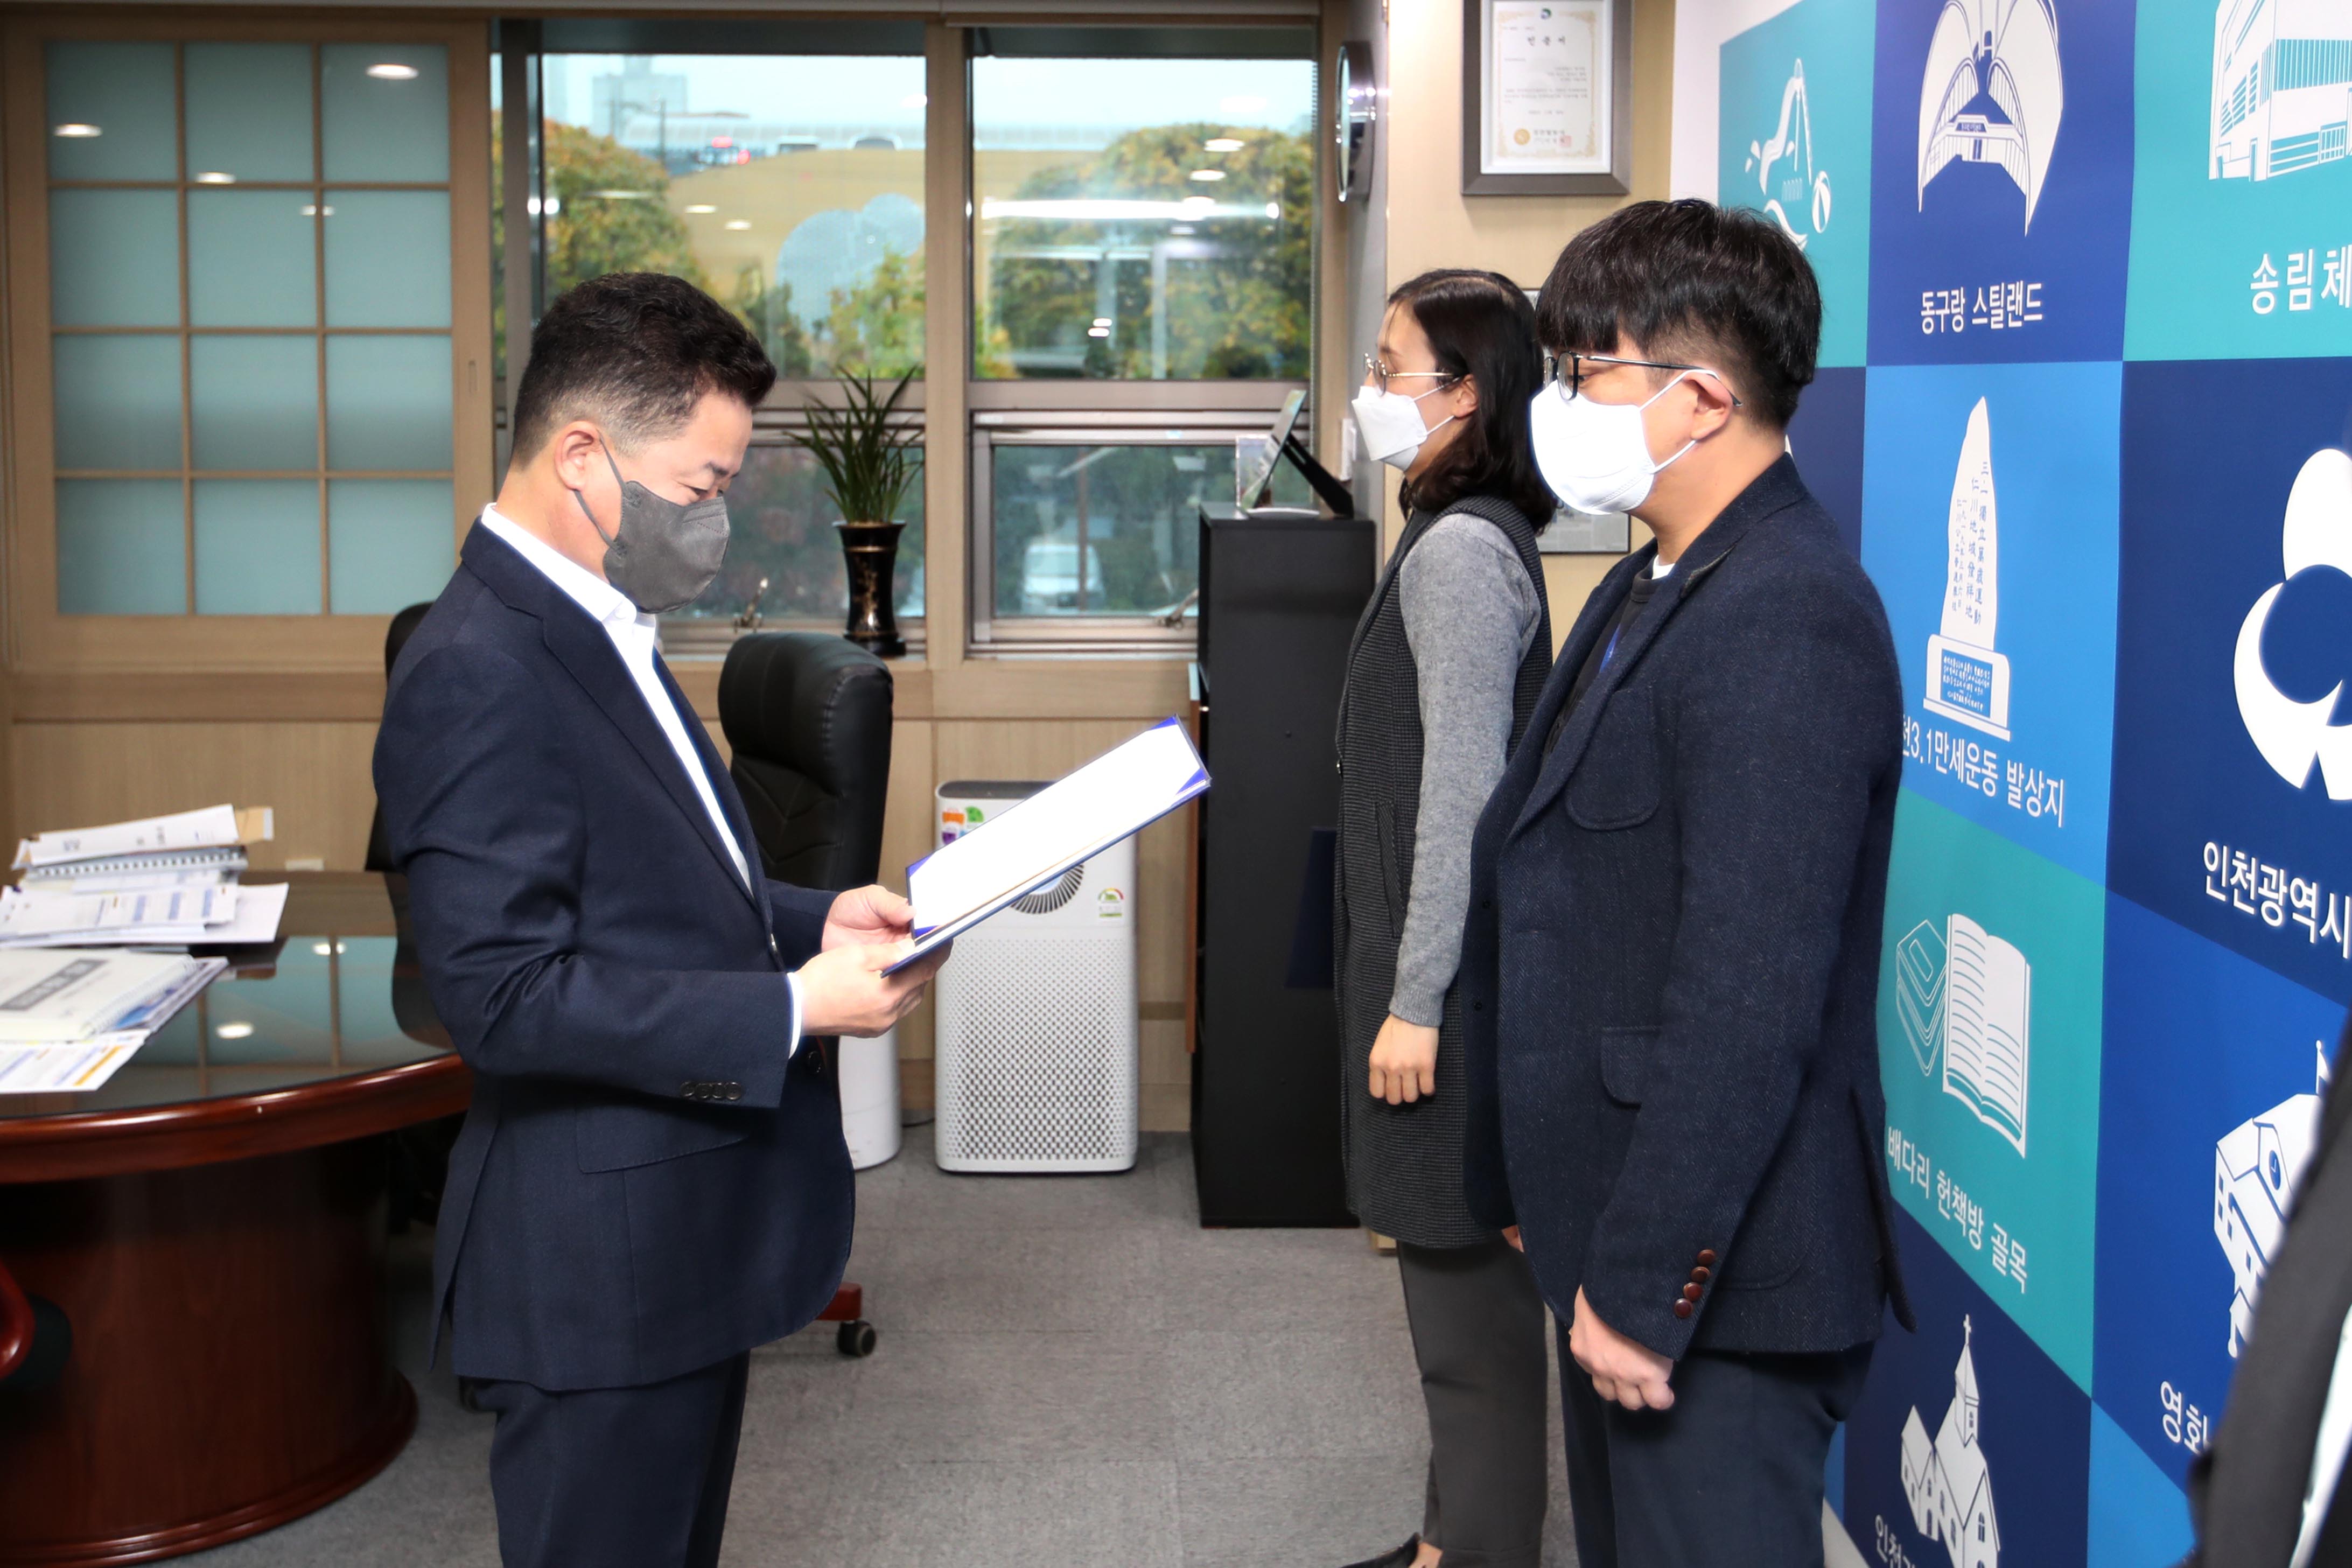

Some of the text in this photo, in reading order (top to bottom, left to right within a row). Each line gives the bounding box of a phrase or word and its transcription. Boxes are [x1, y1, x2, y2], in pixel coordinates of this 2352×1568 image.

[1921, 280, 2042, 335] 동구랑 스틸랜드
[2006, 759, 2063, 828] 발상지
[2203, 841, 2350, 959] 인천광역시
[1888, 1126, 2027, 1294] 배다리 헌책방 골목
[1875, 1514, 1915, 1568] 인천
